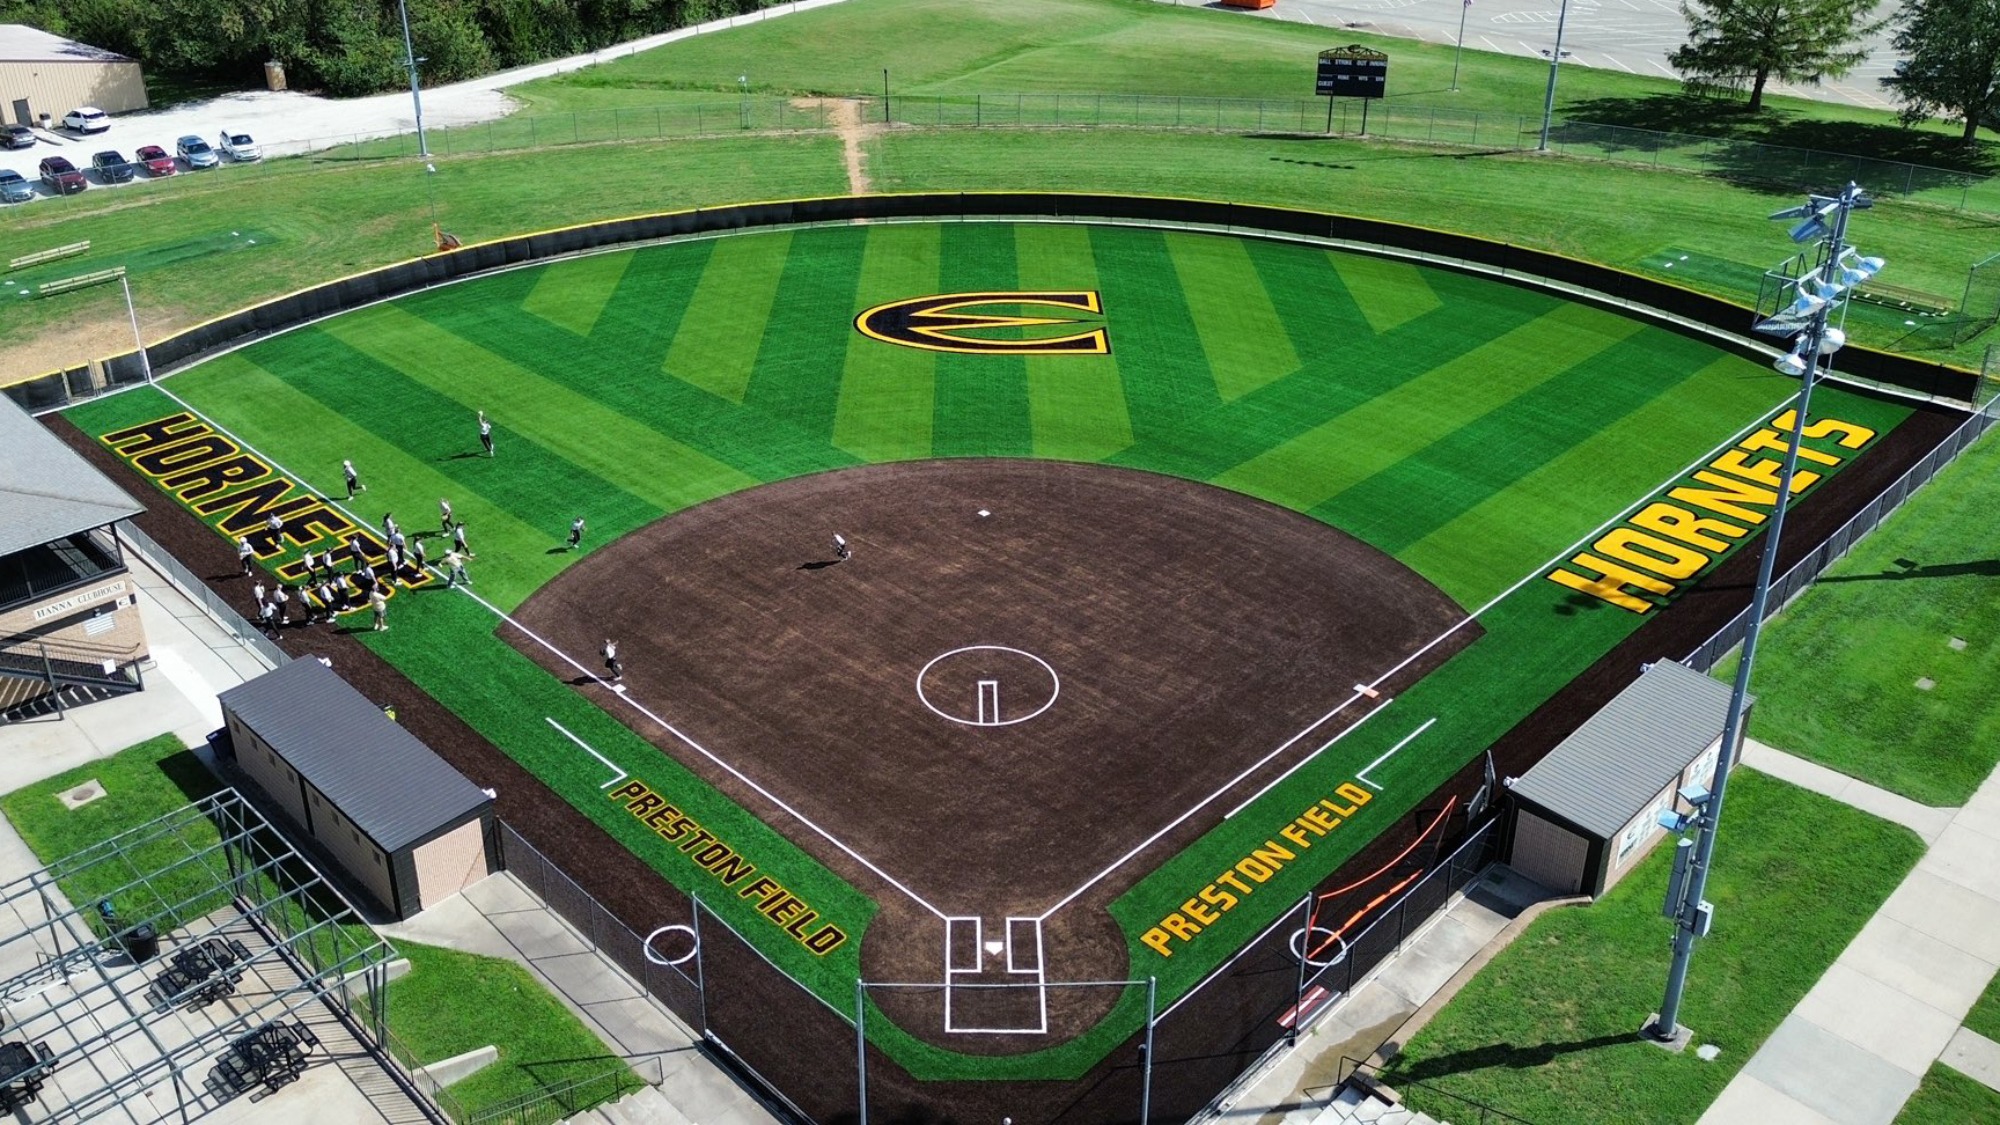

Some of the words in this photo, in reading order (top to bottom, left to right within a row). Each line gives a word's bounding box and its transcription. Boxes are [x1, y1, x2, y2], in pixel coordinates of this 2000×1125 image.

[1545, 408, 1877, 615] HORNETS
[36, 601, 73, 617] HANNA
[77, 583, 122, 603] CLUBHOUSE
[608, 780, 756, 886] PRESTON
[738, 876, 846, 955] FIELD
[1139, 839, 1296, 958] PRESTON
[1279, 781, 1373, 848] FIELD
